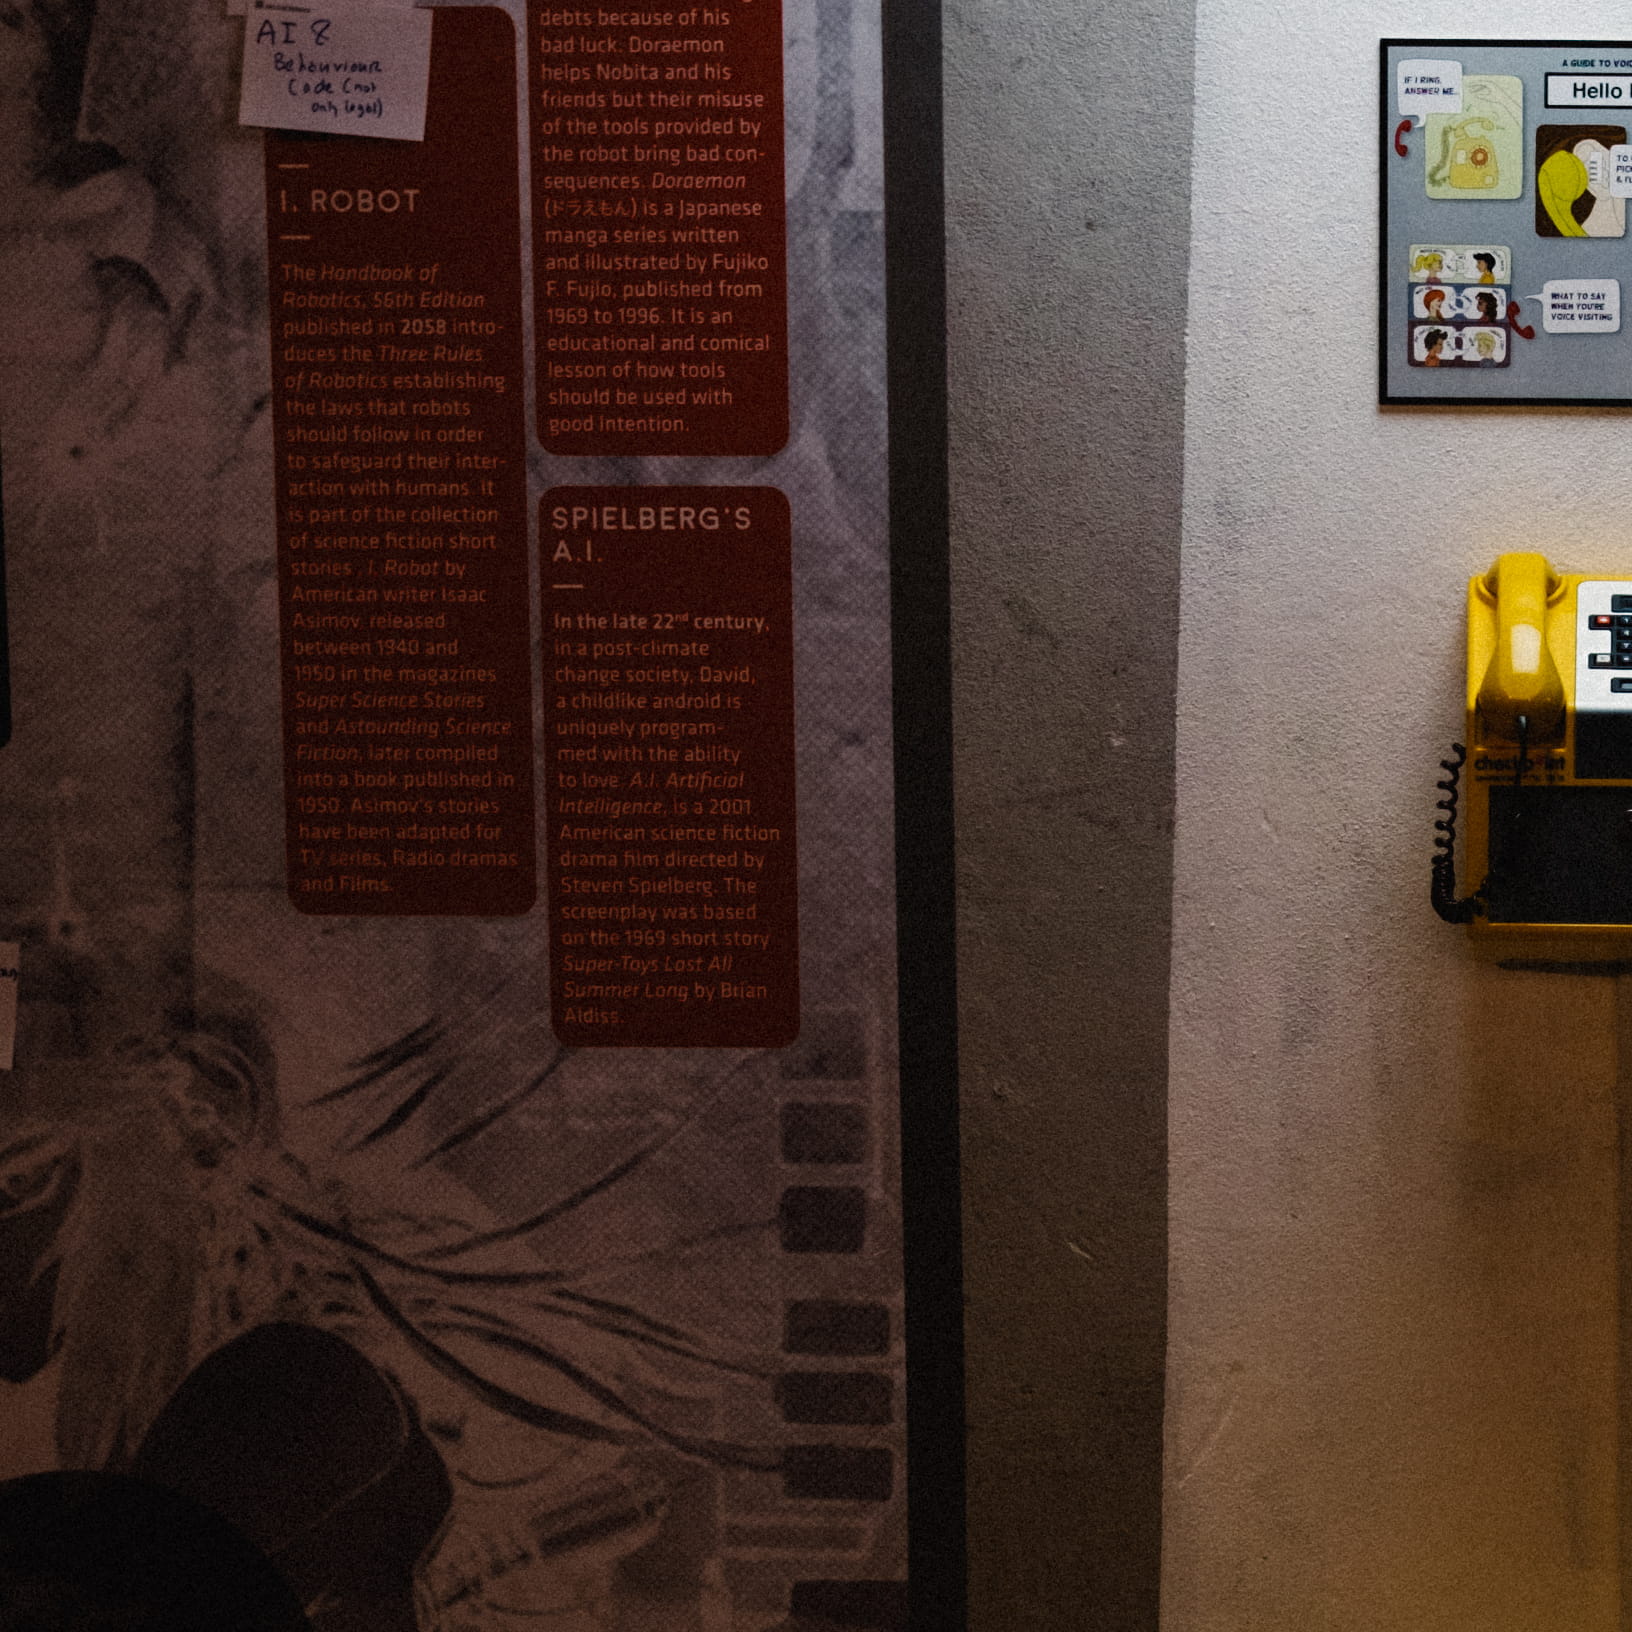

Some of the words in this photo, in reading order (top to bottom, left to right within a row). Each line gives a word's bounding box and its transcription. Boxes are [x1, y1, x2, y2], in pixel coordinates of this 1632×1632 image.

[541, 8, 592, 26] debts
[598, 8, 673, 26] because
[678, 8, 697, 26] of
[703, 8, 731, 26] his
[257, 19, 297, 45] AI
[540, 36, 575, 53] bad
[628, 36, 726, 53] Doraemon
[1573, 82, 1622, 99] Hello
[311, 189, 420, 213] ROBOT
[1551, 313, 1575, 321] VOICE
[548, 415, 595, 436] good
[552, 506, 751, 530] SPIELBERG'S
[555, 612, 572, 629] In
[577, 612, 607, 629] the
[613, 612, 647, 629] late
[653, 612, 689, 629] 22nd
